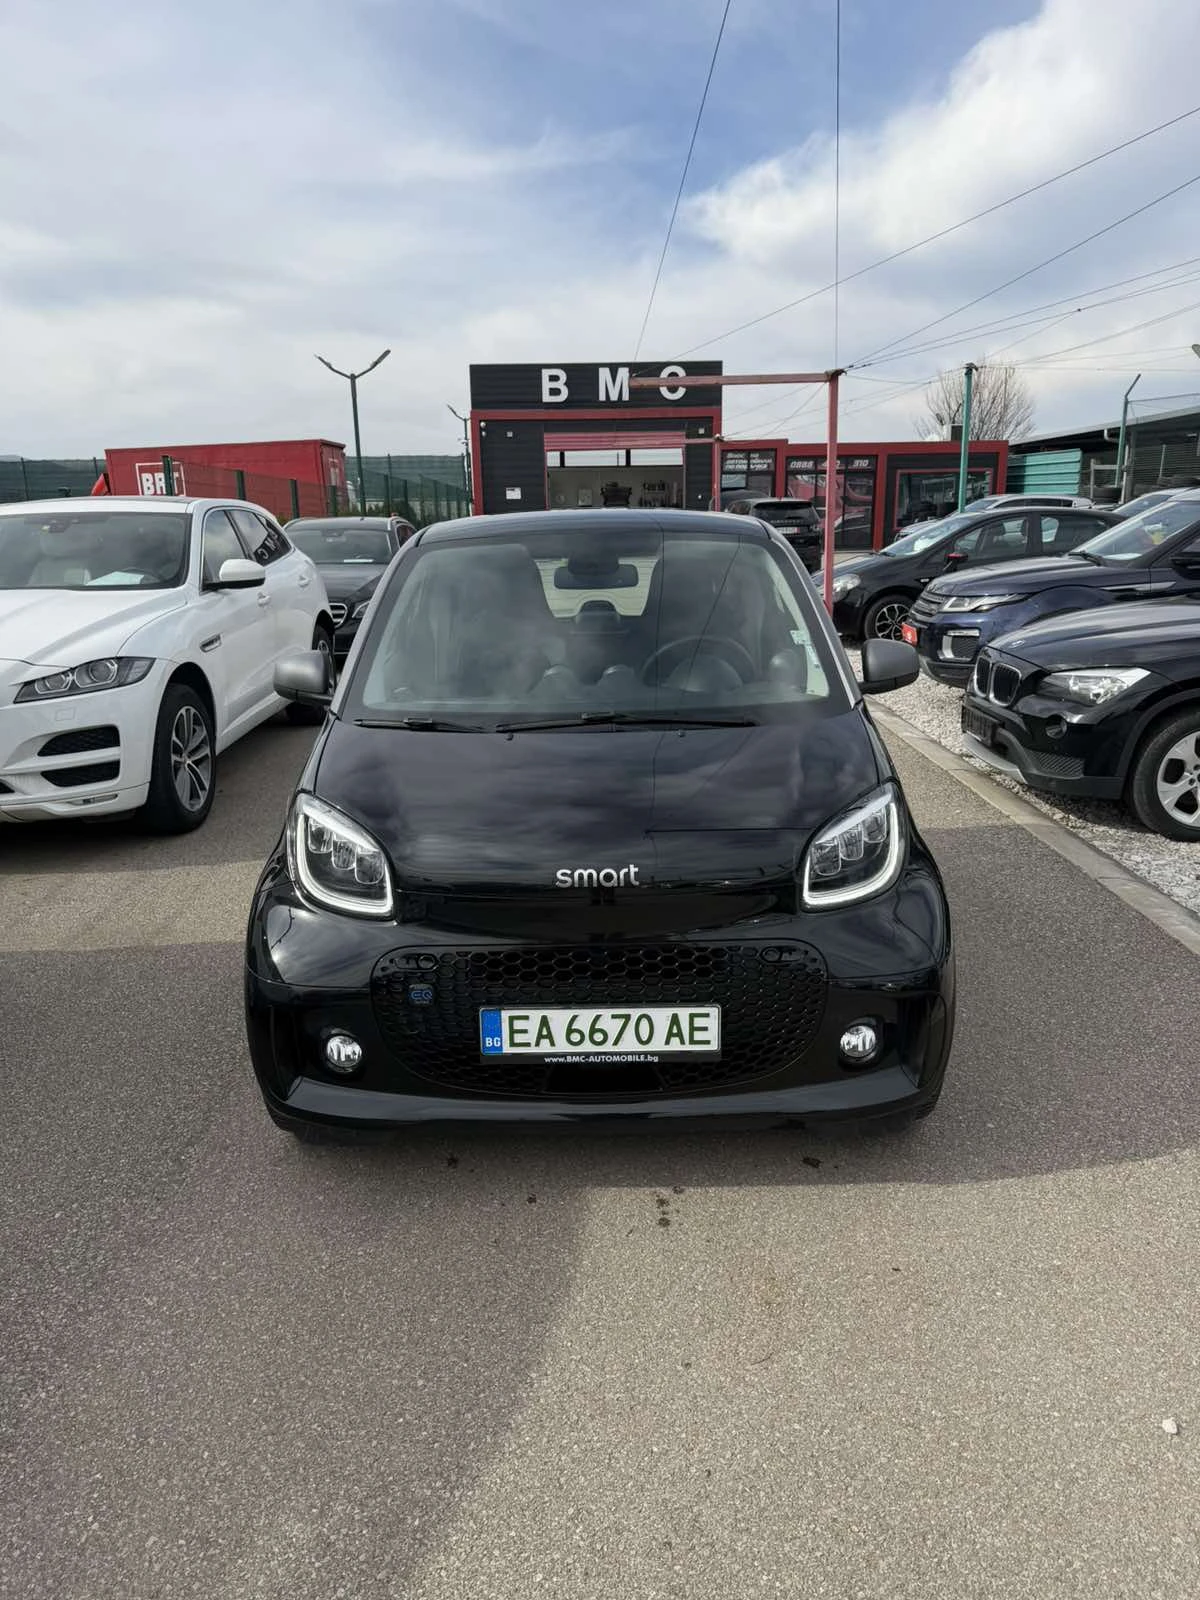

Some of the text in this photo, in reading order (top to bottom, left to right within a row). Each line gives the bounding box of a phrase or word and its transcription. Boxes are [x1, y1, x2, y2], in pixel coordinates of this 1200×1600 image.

[555, 864, 640, 888] smart
[508, 1012, 711, 1047] EA 6670 AE
[485, 1038, 501, 1047] BG
